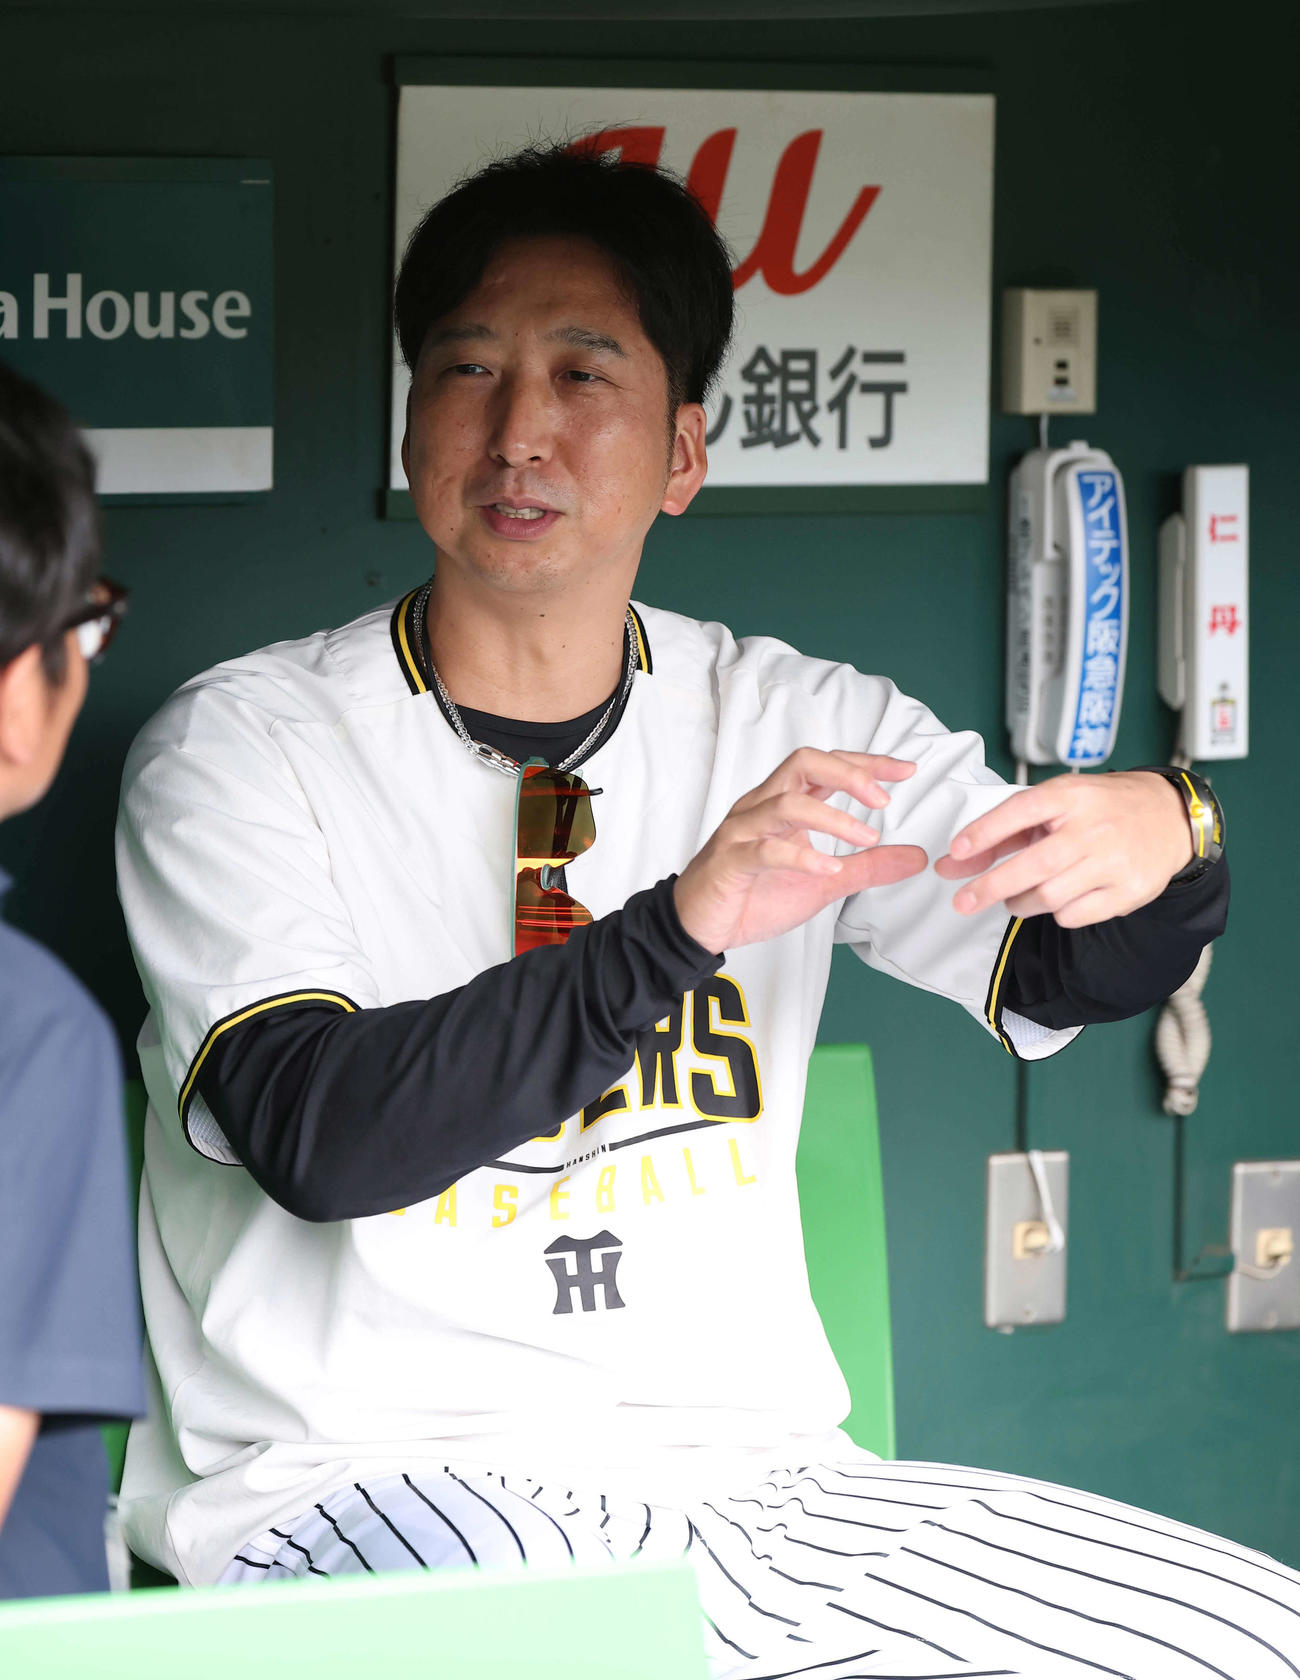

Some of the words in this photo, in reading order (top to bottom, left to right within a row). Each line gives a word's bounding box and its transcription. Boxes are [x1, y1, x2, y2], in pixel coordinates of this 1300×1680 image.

[33, 273, 251, 340] House
[387, 1138, 756, 1228] ASEBALL
[566, 1144, 606, 1168] HANSHIN
